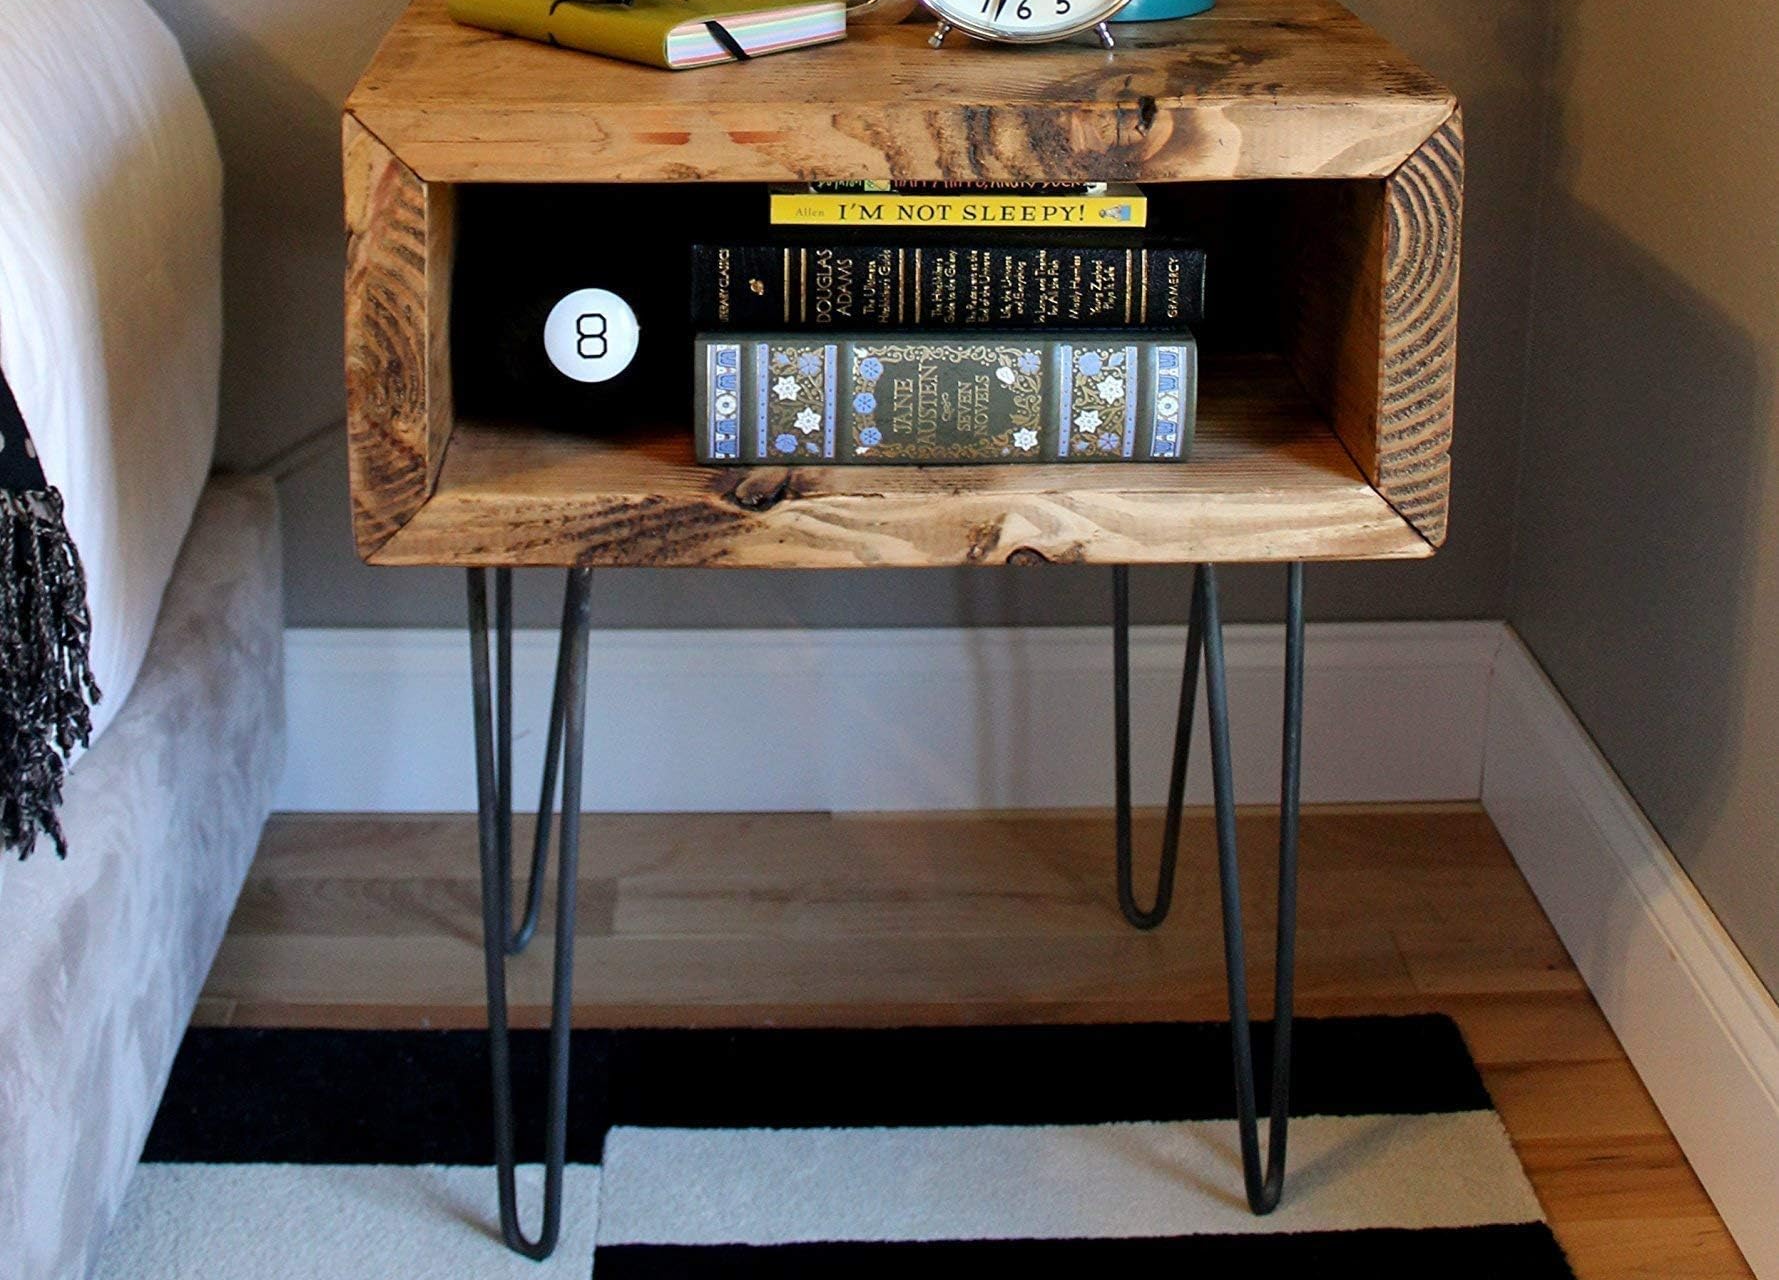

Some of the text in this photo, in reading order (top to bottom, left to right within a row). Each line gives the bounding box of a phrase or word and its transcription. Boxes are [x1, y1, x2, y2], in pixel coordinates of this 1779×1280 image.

[795, 202, 1085, 222] Allen I'M NOT SLEEPY!
[816, 249, 833, 323] DOUGLAS
[836, 258, 853, 317] ADAMS
[878, 249, 891, 276] Guide
[1167, 256, 1180, 318] GRAMERCY
[576, 312, 608, 359] 8
[892, 378, 913, 434] JANE
[917, 363, 938, 446] AUSTEN
[956, 380, 972, 432] SEVEN
[974, 374, 990, 438] NOVELS
